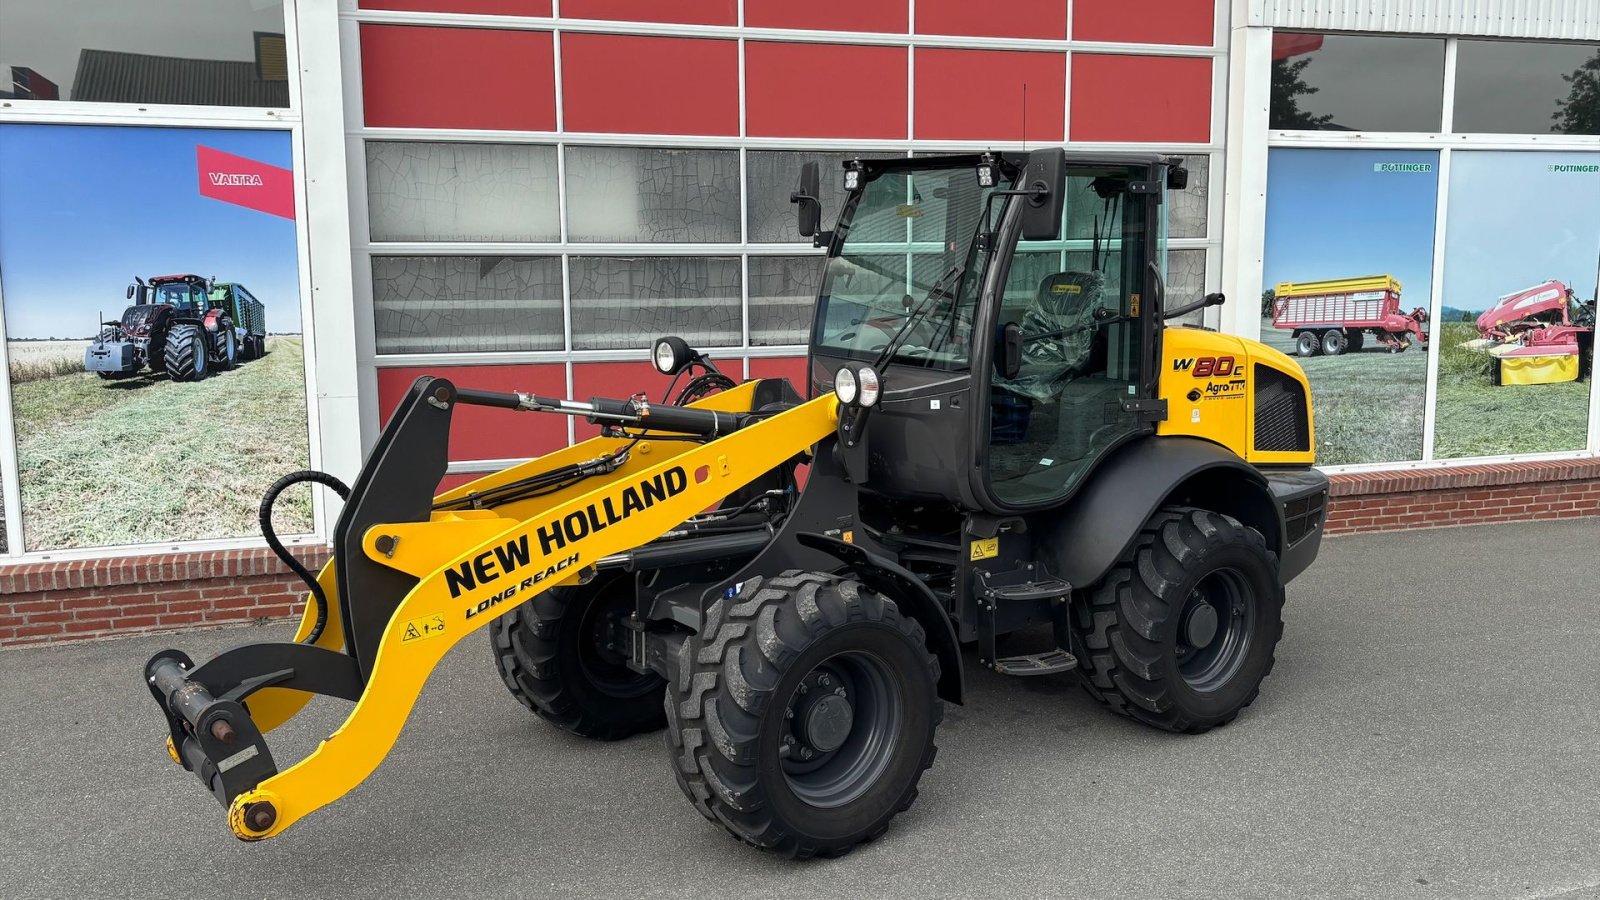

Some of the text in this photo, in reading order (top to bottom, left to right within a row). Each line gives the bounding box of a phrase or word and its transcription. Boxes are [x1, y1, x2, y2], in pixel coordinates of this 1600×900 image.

[208, 172, 263, 186] VALTRA
[444, 466, 687, 599] NEW HOLLAND
[466, 552, 579, 619] LONG REACH
